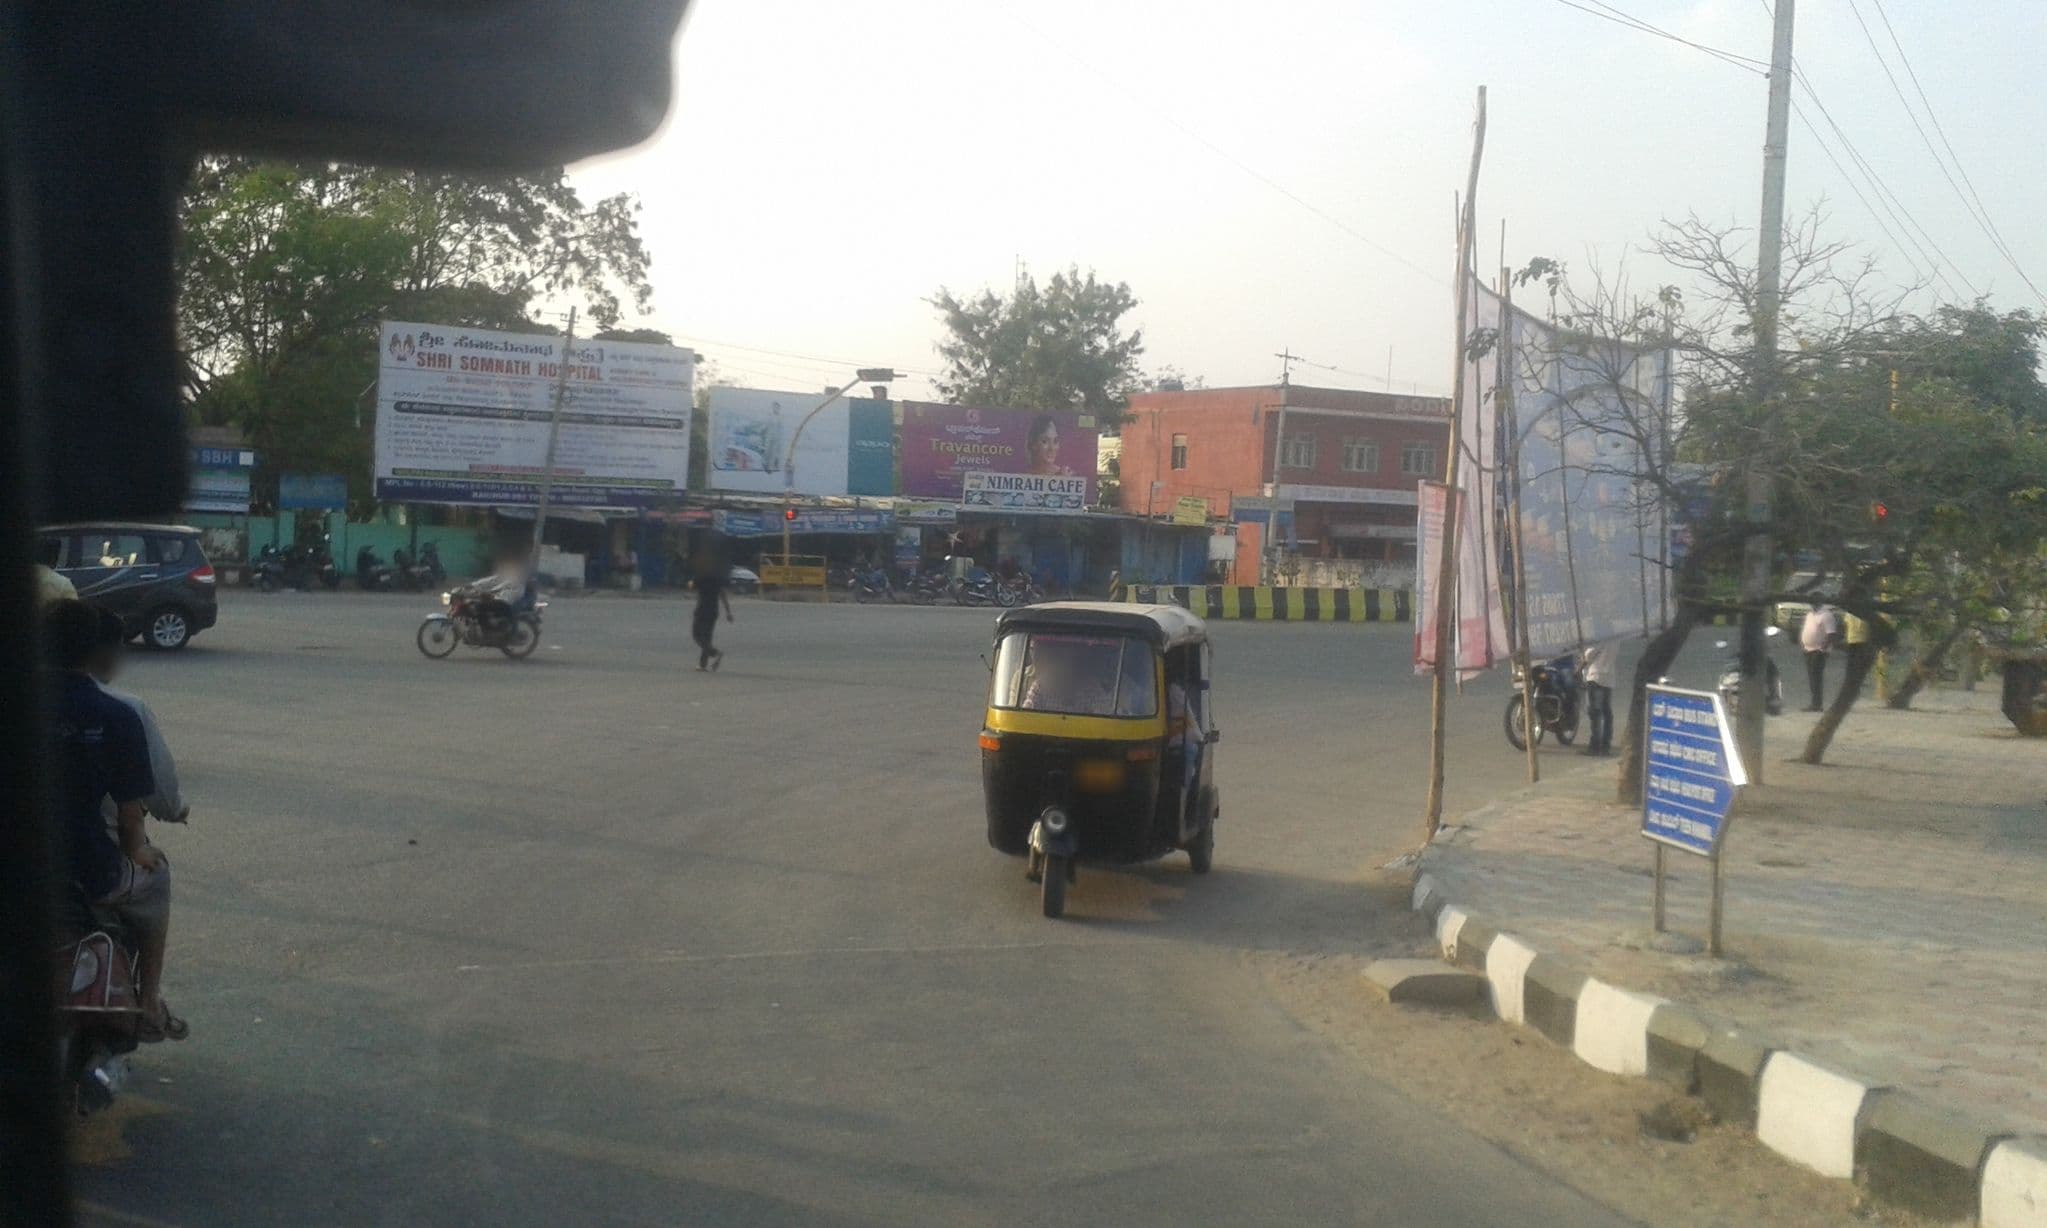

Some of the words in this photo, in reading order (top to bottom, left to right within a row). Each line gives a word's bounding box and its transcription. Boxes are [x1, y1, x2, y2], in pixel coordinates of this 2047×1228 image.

[416, 351, 452, 369] SHRI
[460, 355, 531, 375] SOMNATH
[929, 438, 1014, 456] Travancore
[954, 454, 991, 465] Jewels
[986, 475, 1044, 492] NIMRAH
[1047, 478, 1084, 493] CAFE
